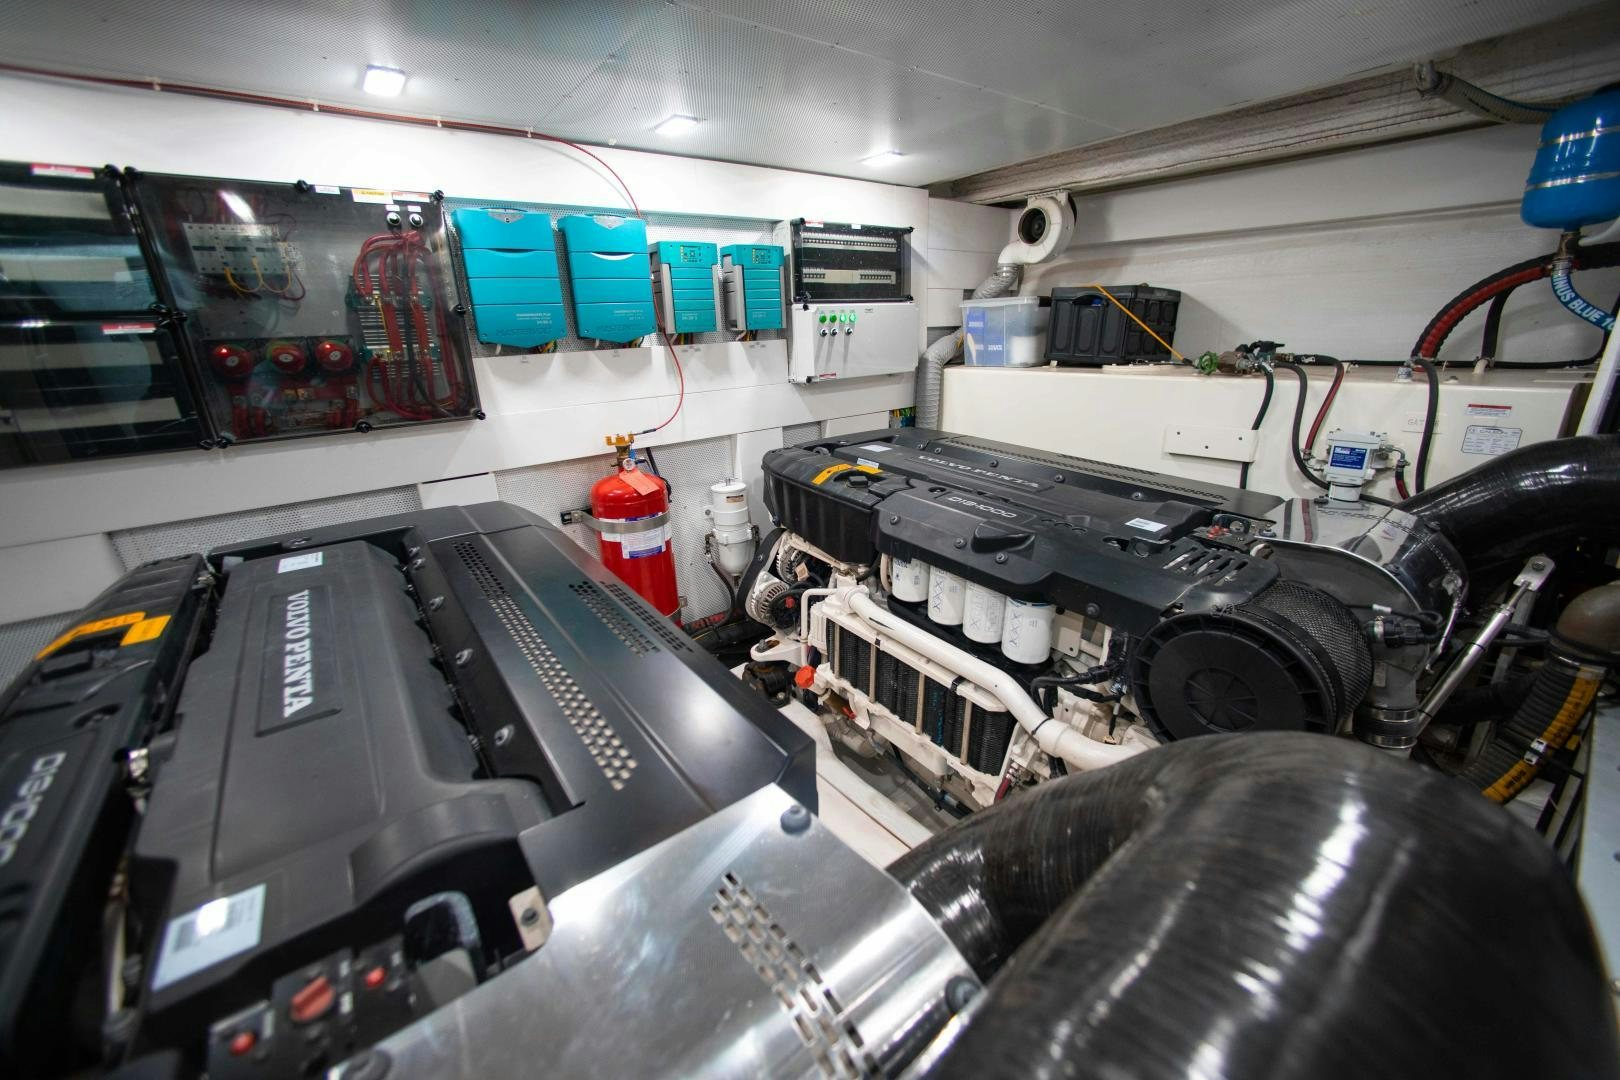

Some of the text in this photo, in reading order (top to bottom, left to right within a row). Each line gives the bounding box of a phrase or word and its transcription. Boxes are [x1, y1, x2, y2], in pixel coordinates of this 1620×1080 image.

[1569, 299, 1604, 321] BLUE
[286, 589, 310, 640] VOLVO
[283, 639, 313, 718] PENTA
